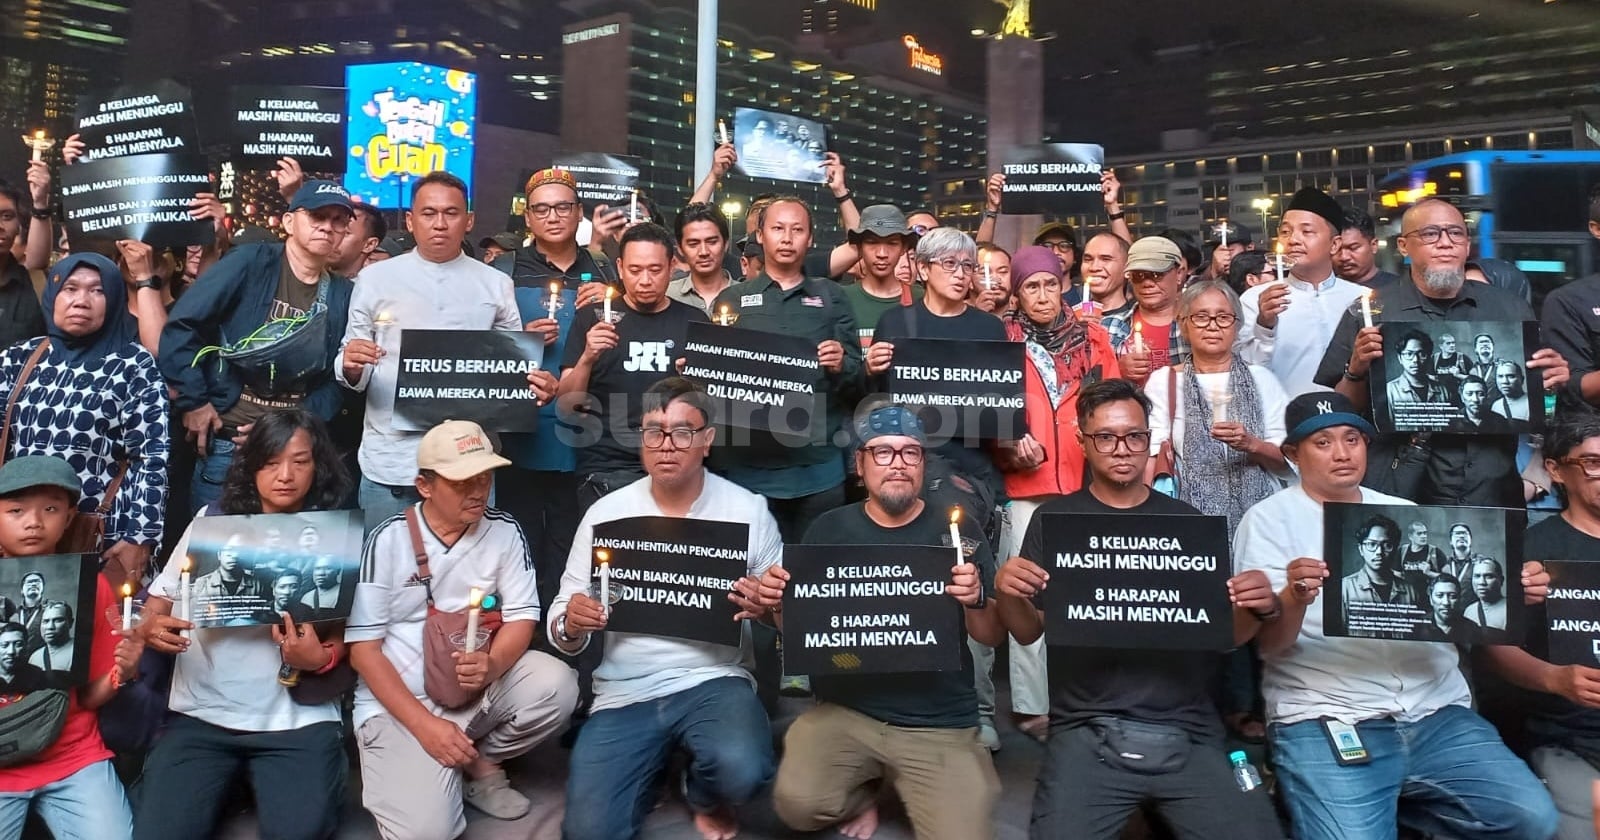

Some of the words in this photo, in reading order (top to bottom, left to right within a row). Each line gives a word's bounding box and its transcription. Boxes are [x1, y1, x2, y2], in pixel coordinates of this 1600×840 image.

[100, 103, 107, 112] 8
[108, 95, 160, 111] KELUARGA
[259, 100, 266, 109] 8
[267, 100, 318, 110] KELUARGA
[80, 113, 115, 128] MASIH
[116, 102, 184, 122] MENUNGGU
[238, 111, 272, 121] MASIH
[274, 111, 340, 123] MENUNGGU
[105, 135, 113, 144] 8
[115, 128, 163, 143] HARAPAN
[259, 133, 266, 142] 8
[267, 133, 314, 143] HARAPAN
[89, 145, 128, 160] MASIH
[129, 136, 184, 154] MENYALA
[243, 144, 276, 154] MASIH
[277, 145, 332, 157] MENYALA
[1004, 163, 1039, 174] TERUS
[1041, 163, 1101, 174] BERHARAP
[70, 184, 92, 194] JIWA
[92, 179, 122, 191] MASIH
[123, 175, 178, 186] MENUNGGU
[178, 174, 209, 183] KABAR
[1003, 183, 1028, 192] BAWA
[1029, 183, 1065, 192] MEREKA
[1066, 183, 1102, 192] PULANG
[75, 205, 117, 219] JURNALIS
[119, 200, 139, 211] DAN
[149, 199, 177, 208] AWAK
[178, 198, 198, 206] KAP
[82, 218, 122, 232] BELUM
[685, 342, 722, 356] JANGAN
[722, 347, 767, 362] HENTIKAN
[767, 354, 819, 370] PENCARIAN
[403, 359, 452, 373] TERUS
[455, 360, 538, 374] BERHARAP
[682, 366, 725, 381] JANGAN
[726, 372, 771, 388] BIARKAN
[772, 379, 814, 394] MEREKA
[894, 366, 940, 381] TERUS
[943, 367, 1023, 384] BERHARAP
[399, 387, 434, 399] BAWA
[436, 388, 486, 399] MEREKA
[488, 388, 537, 400] PULANG
[707, 384, 785, 407] DILUPAKAN
[893, 393, 926, 405] BAWA
[928, 394, 975, 407] MEREKA
[976, 396, 1024, 409] PULANG
[592, 538, 634, 551] JANGAN
[636, 541, 687, 555] HENTIKAN
[689, 546, 747, 561] PENCARIAN
[1089, 536, 1099, 549] 8
[1102, 536, 1182, 551] KELUARGA
[1056, 553, 1111, 569] MASIH
[1115, 554, 1217, 571] MENUNGGU
[826, 566, 836, 579] 8
[838, 565, 912, 579] KELUARGA
[643, 571, 694, 587] BIARKAN
[696, 576, 735, 591] MEREK
[794, 583, 846, 598] MASIH
[850, 581, 944, 597] MENUNGGU
[1095, 588, 1104, 601] 8
[1108, 588, 1180, 603] HARAPAN
[623, 586, 712, 610] DILUPAKAN
[830, 615, 839, 628] 8
[842, 614, 910, 628] HARAPAN
[1067, 605, 1123, 621] MASIH
[1127, 606, 1210, 624] MENYALA
[1550, 620, 1600, 632] JANGA
[805, 633, 857, 648] MASIH
[861, 630, 937, 647] MENYALA
